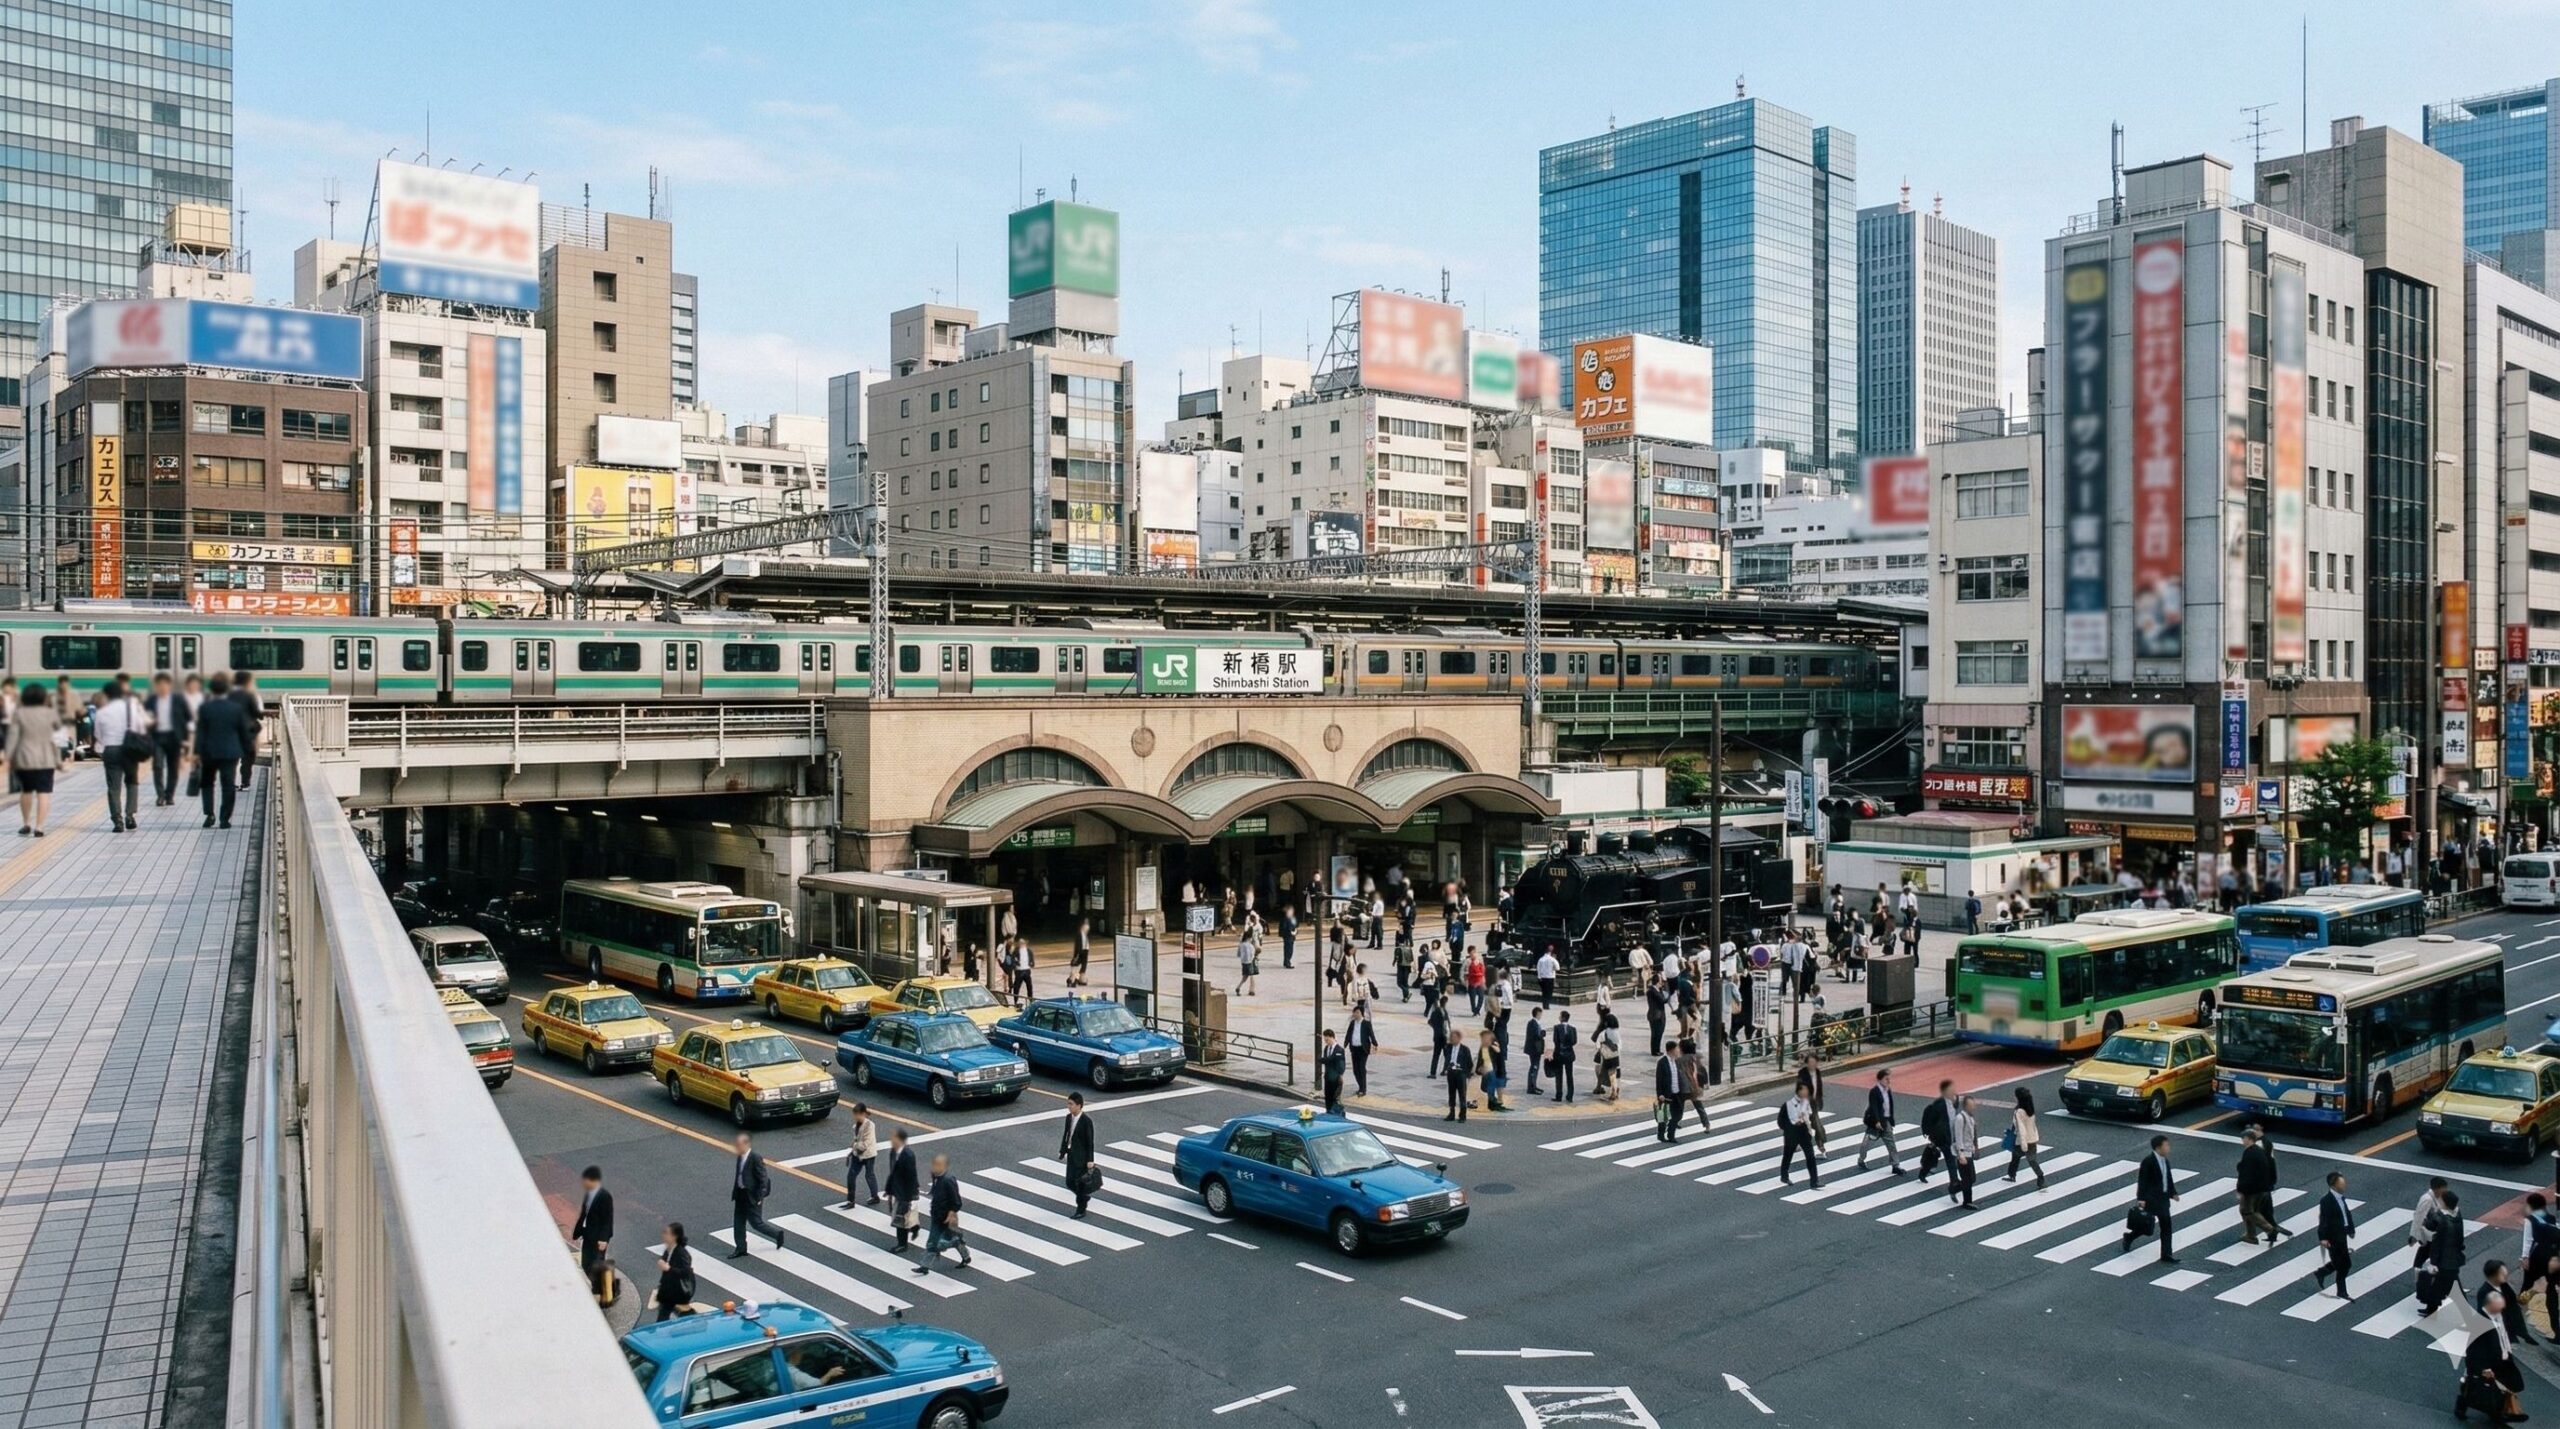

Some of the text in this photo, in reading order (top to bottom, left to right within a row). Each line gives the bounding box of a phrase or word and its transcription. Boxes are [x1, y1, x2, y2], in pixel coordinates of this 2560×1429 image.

[1580, 395, 1627, 419] カフェ
[231, 545, 277, 560] カフェ
[1153, 654, 1189, 678] JR
[1222, 652, 1297, 675] 新橋駅
[1213, 677, 1309, 689] Shimbashi Station
